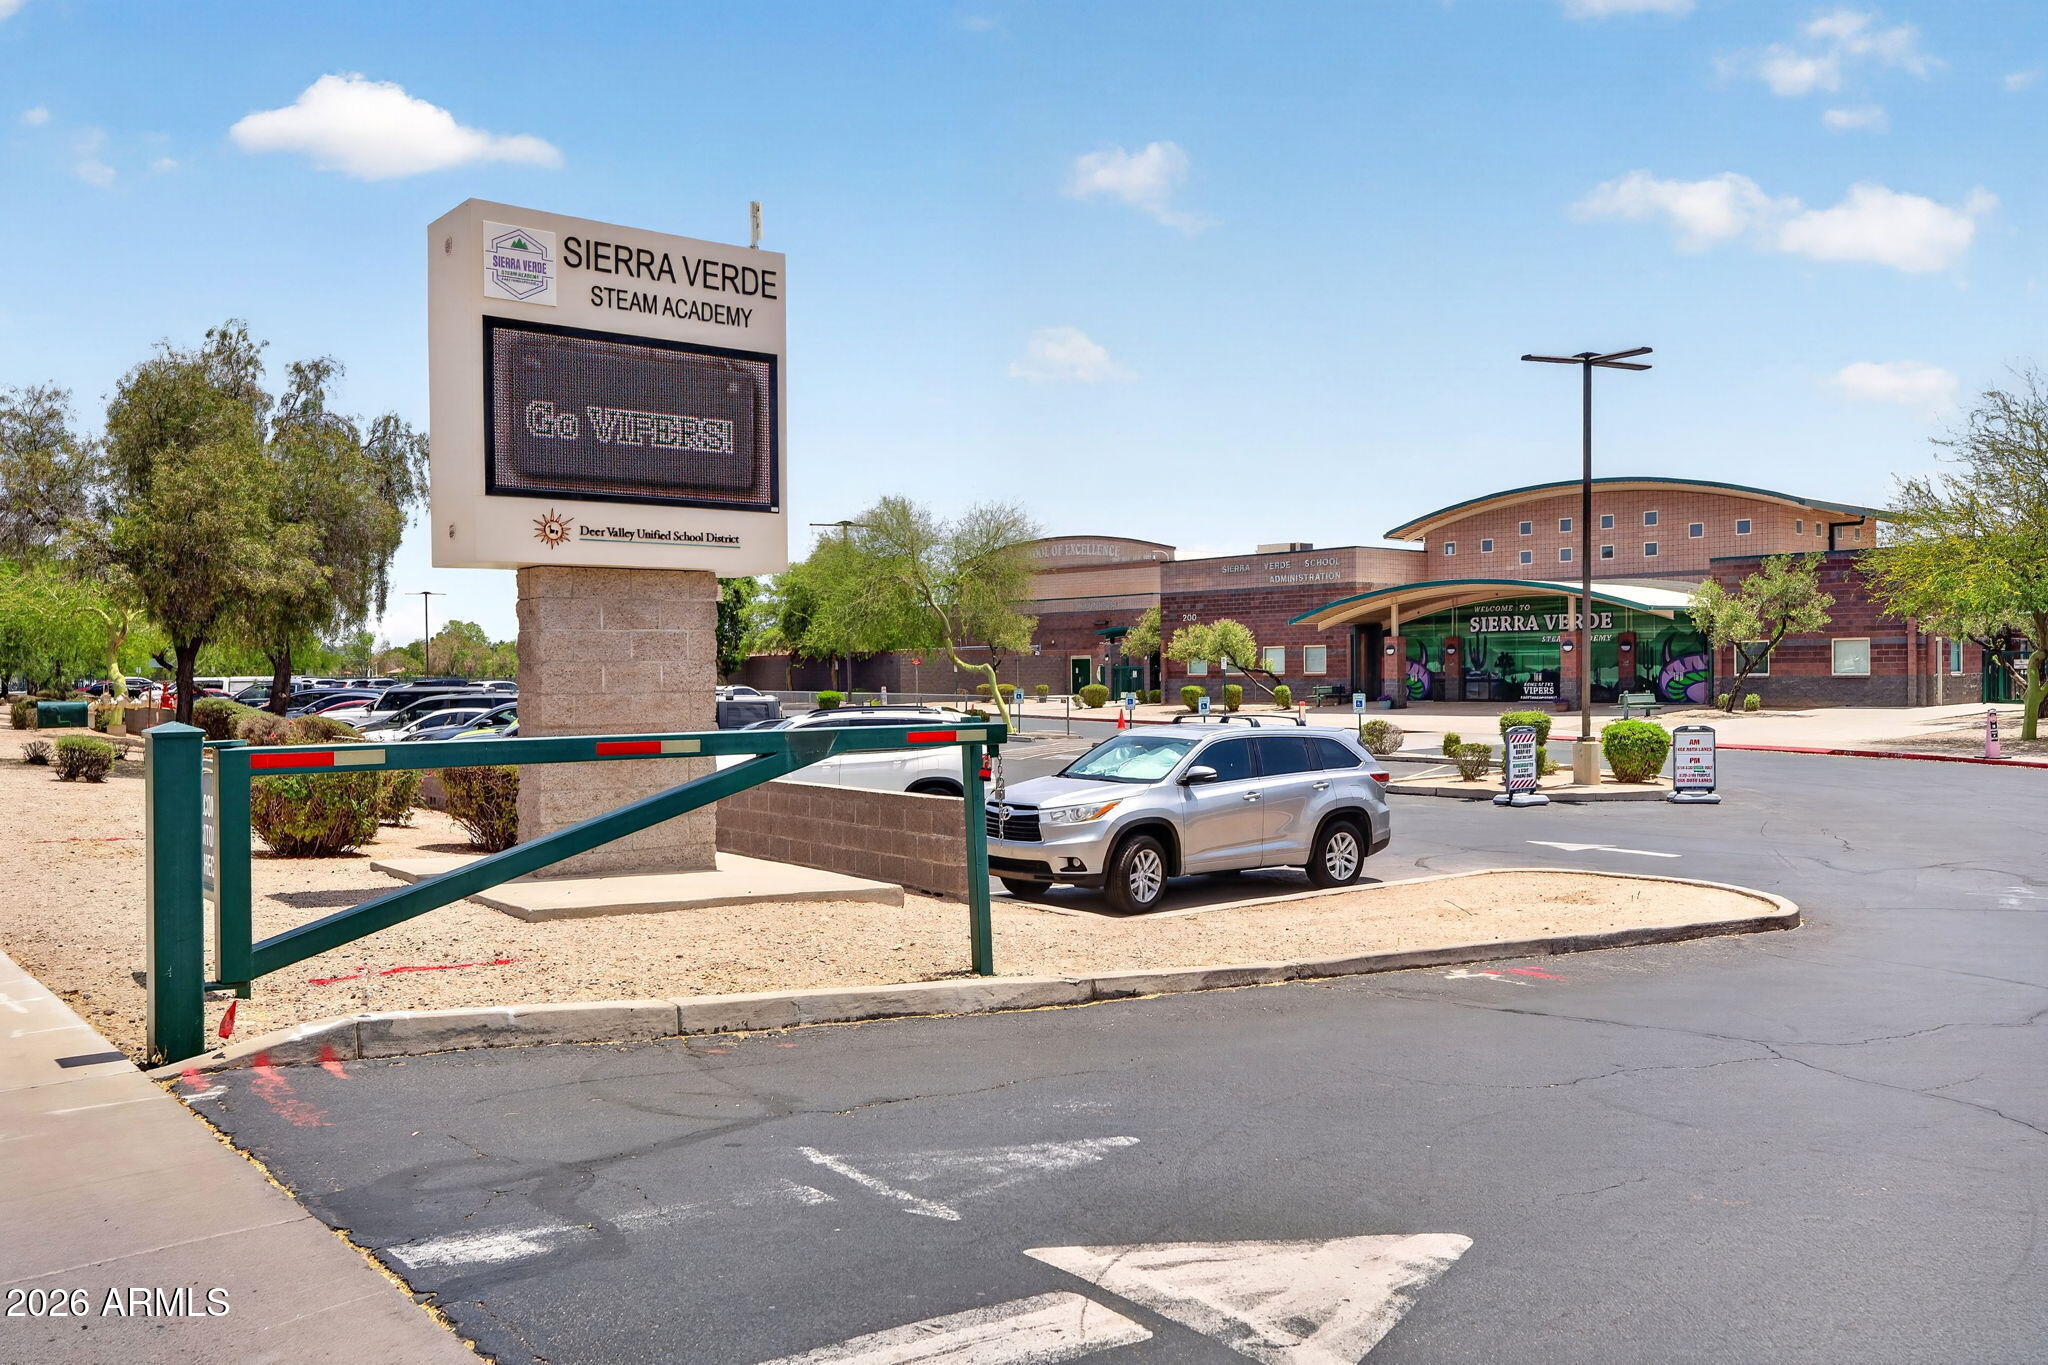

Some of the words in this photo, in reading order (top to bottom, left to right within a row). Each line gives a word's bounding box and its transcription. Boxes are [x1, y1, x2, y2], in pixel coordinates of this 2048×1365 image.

[492, 254, 521, 271] SIERRA
[522, 260, 547, 275] VERDE
[563, 236, 677, 285] SIERRA
[682, 255, 778, 300] VERDE
[590, 285, 658, 316] STEAM
[662, 296, 753, 328] ACADEMY
[526, 400, 579, 440] Go
[585, 405, 734, 454] VIPERS!
[579, 525, 605, 537] Deer
[606, 527, 635, 542] Valley
[637, 528, 671, 541] Unified
[673, 531, 704, 542] School
[706, 532, 740, 544] District
[1051, 545, 1064, 557] OF
[1065, 543, 1122, 558] EXCELLENCE
[1222, 564, 1250, 574] SIERRA
[1263, 561, 1292, 570] VERDE
[1304, 557, 1339, 568] SCHOOL
[1269, 571, 1341, 583] ADMINISTRATION
[1474, 604, 1513, 613] WELCOME
[1520, 603, 1531, 611] TO
[1182, 613, 1197, 622] 200
[1470, 614, 1540, 633] SIERRA
[1543, 612, 1613, 631] VERDE
[1523, 686, 1554, 695] VIPERS
